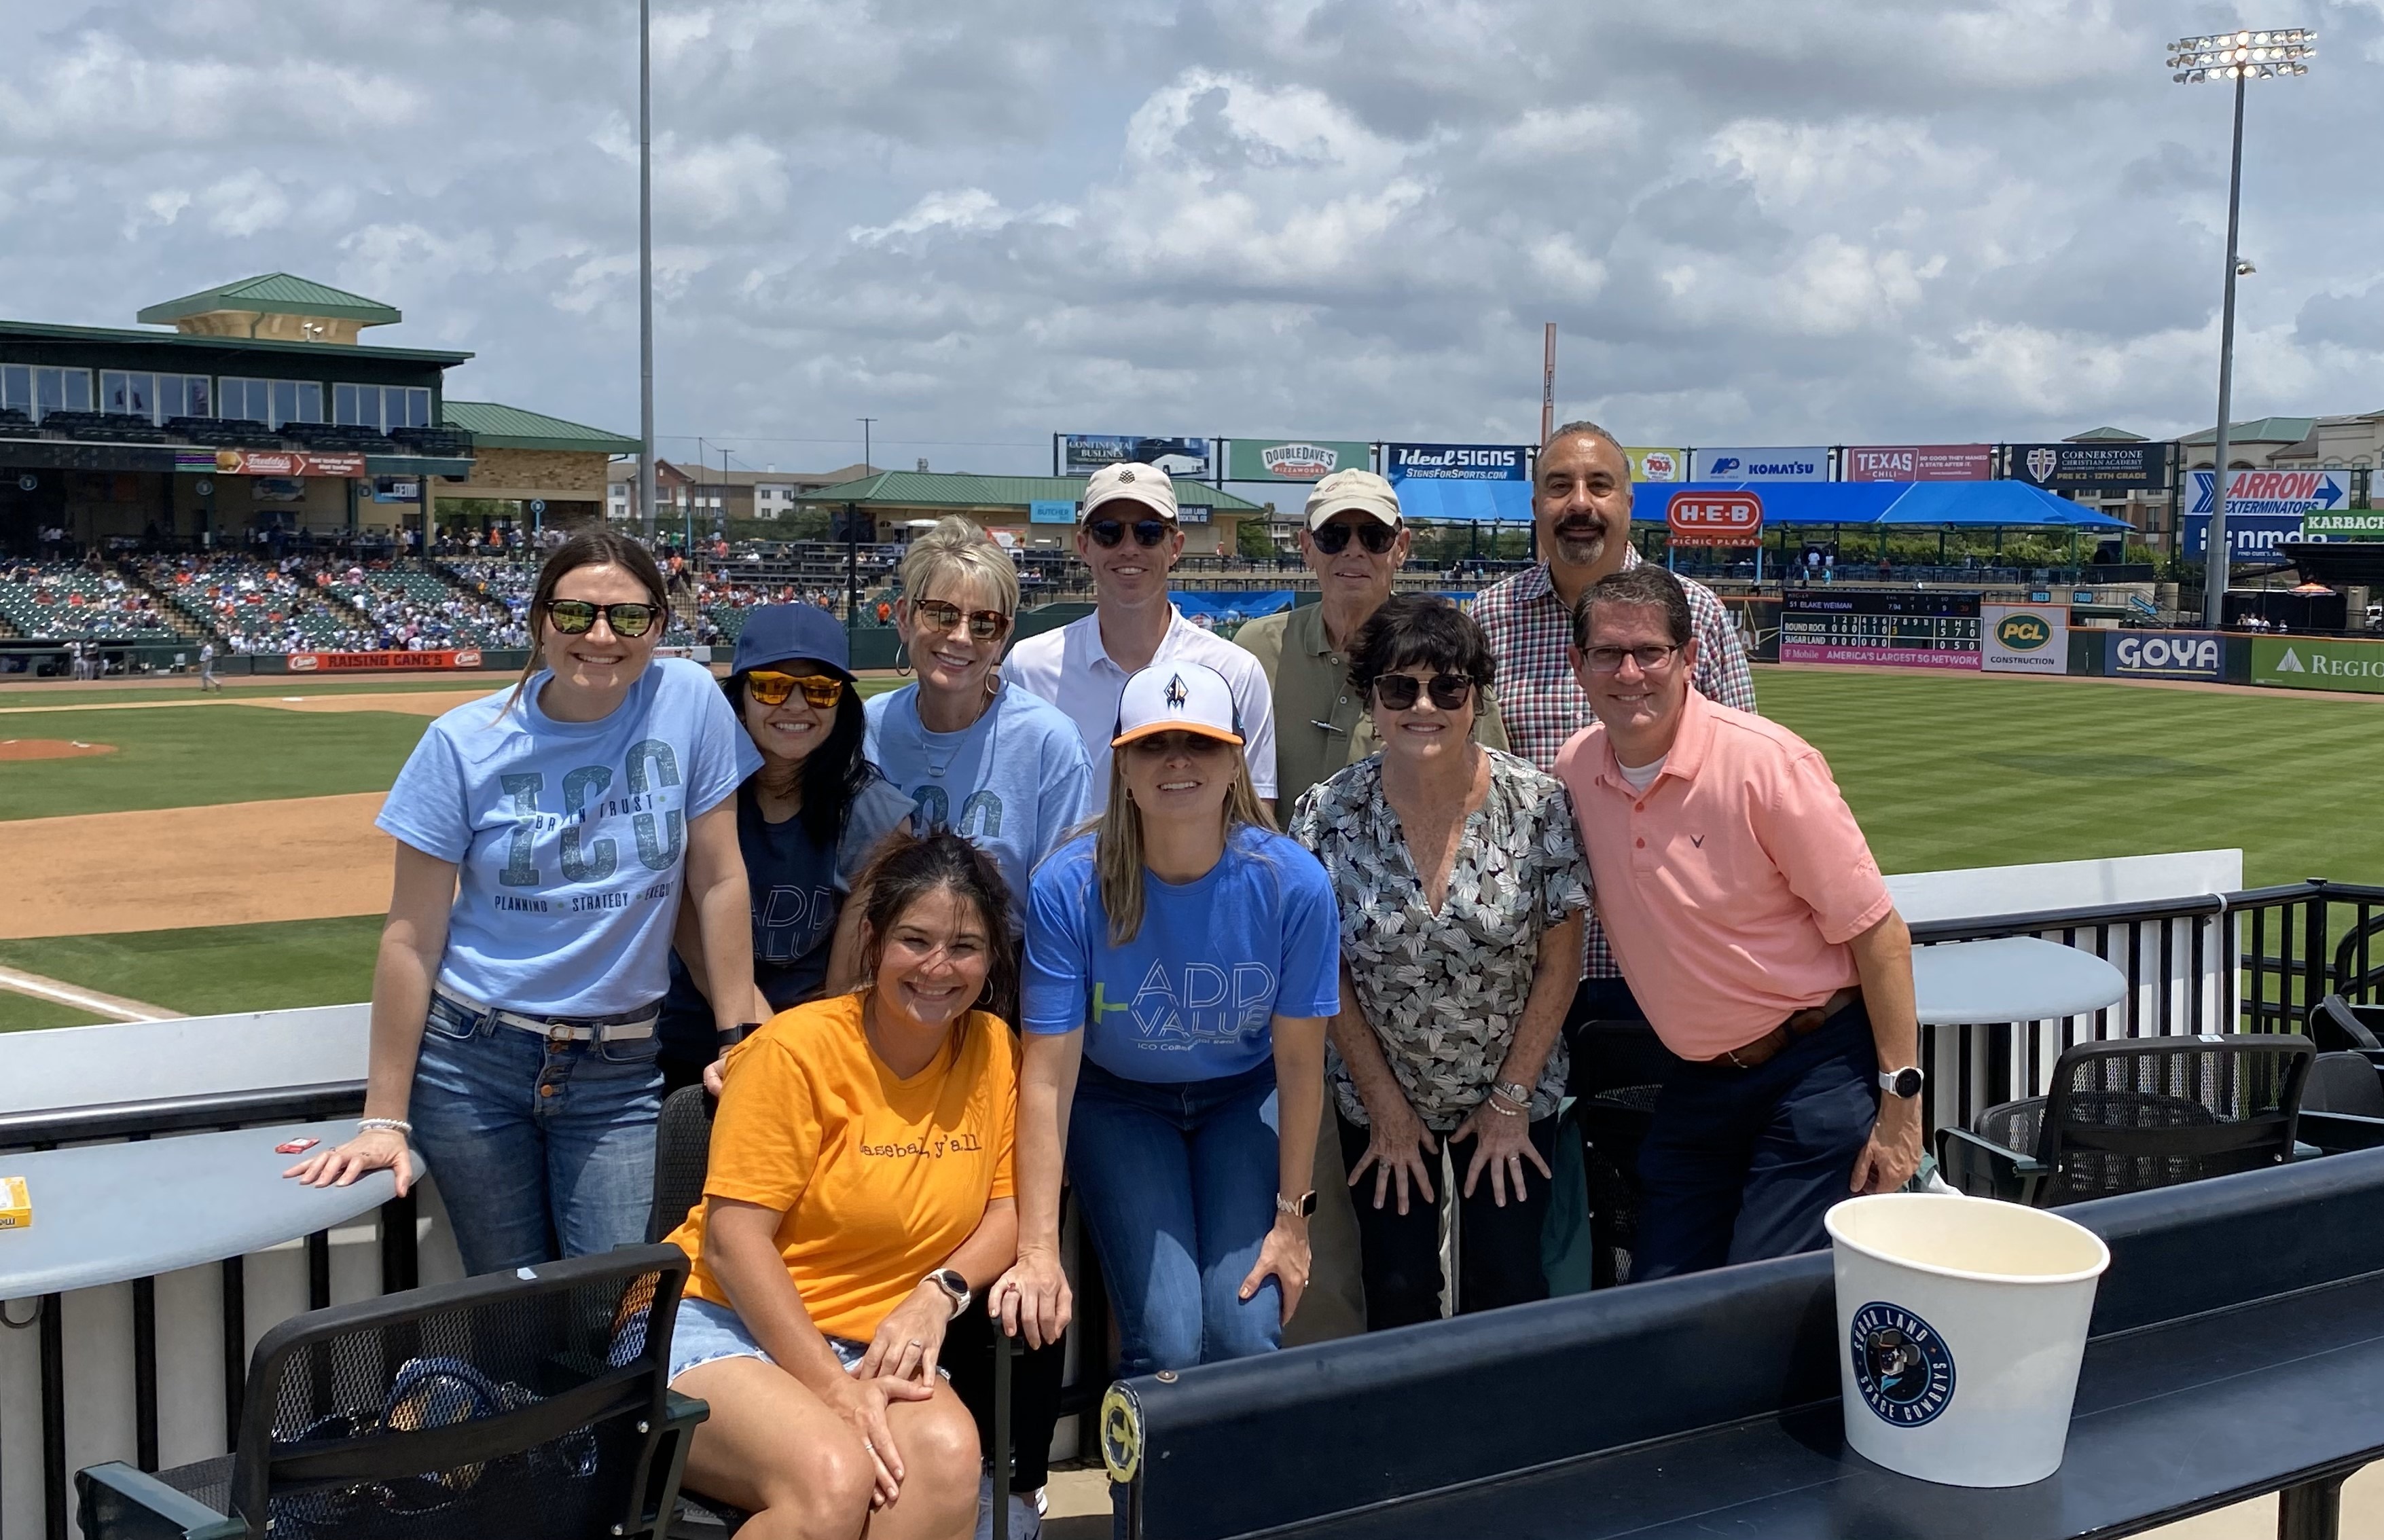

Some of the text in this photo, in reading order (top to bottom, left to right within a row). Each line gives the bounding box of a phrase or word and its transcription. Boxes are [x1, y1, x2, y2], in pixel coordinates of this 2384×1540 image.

[1069, 441, 1133, 450] CONTINENTAL
[1081, 449, 1123, 458] BUSLINES
[1398, 449, 1515, 466] Ideal SIGNS
[2062, 450, 2143, 459] CORNERSTONE
[1749, 461, 1813, 474] KOMATSU
[1857, 453, 1912, 472] TEXAS
[2227, 473, 2324, 498] ARROW
[2032, 592, 2049, 602] BEER
[2074, 592, 2092, 602] FOOD
[1784, 623, 1807, 631] ROUND
[1809, 623, 1826, 632] ROCK
[1832, 624, 1837, 632] 0
[1841, 625, 1847, 633] 0
[1852, 625, 1857, 633] 0
[1862, 625, 1867, 634] 1
[1873, 625, 1877, 634] 1
[1881, 625, 1887, 634] 0
[1940, 628, 1946, 636] 5
[1955, 628, 1961, 636] 7
[1970, 629, 1975, 637] 0
[2004, 623, 2044, 640] PCL
[1784, 635, 1807, 644] SUGAR
[1807, 636, 1826, 644] LAND
[1832, 637, 1837, 645] 0
[1851, 638, 1856, 646] 0
[1861, 638, 1866, 646] 0
[1871, 638, 1877, 646] 0
[1881, 639, 1887, 647] 0
[1940, 641, 1945, 649] 0
[1969, 642, 1974, 650] 0
[1826, 650, 1979, 665] AMERICA'S LARGEST 5G NETWORK
[2117, 637, 2218, 668] GOYA
[327, 654, 442, 667] RAISING CANE'S
[1991, 657, 2055, 665] CONSTRUCTION
[499, 739, 681, 887] ICO
[572, 892, 628, 912] STRATEGY
[935, 1133, 982, 1158] y'all
[1854, 1310, 1928, 1351] SUGAR LAND
[1861, 1363, 1948, 1420] SPACE COWBOYS
